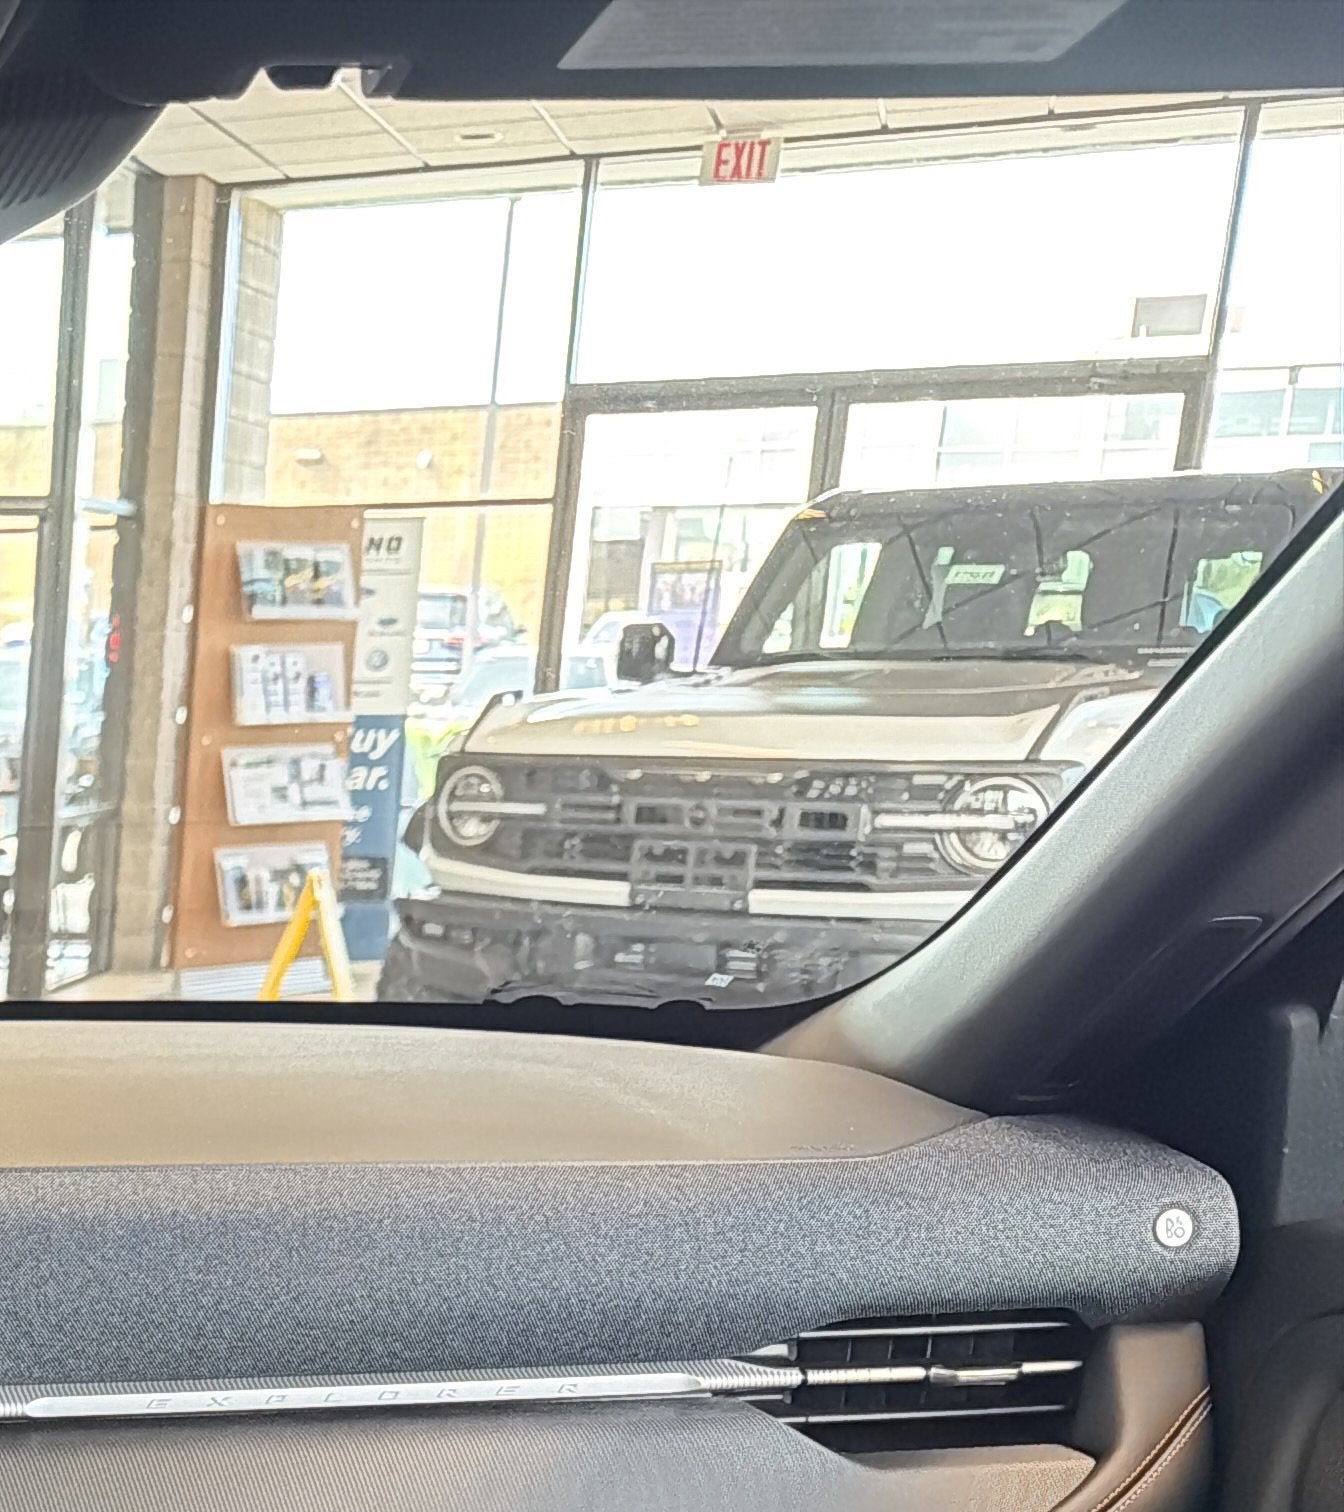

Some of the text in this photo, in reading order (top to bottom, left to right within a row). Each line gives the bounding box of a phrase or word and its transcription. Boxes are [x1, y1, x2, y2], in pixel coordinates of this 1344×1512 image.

[714, 139, 771, 180] EXIT
[350, 727, 401, 760] uy
[347, 765, 389, 790] ar.
[146, 1383, 579, 1409] EXPLORER
